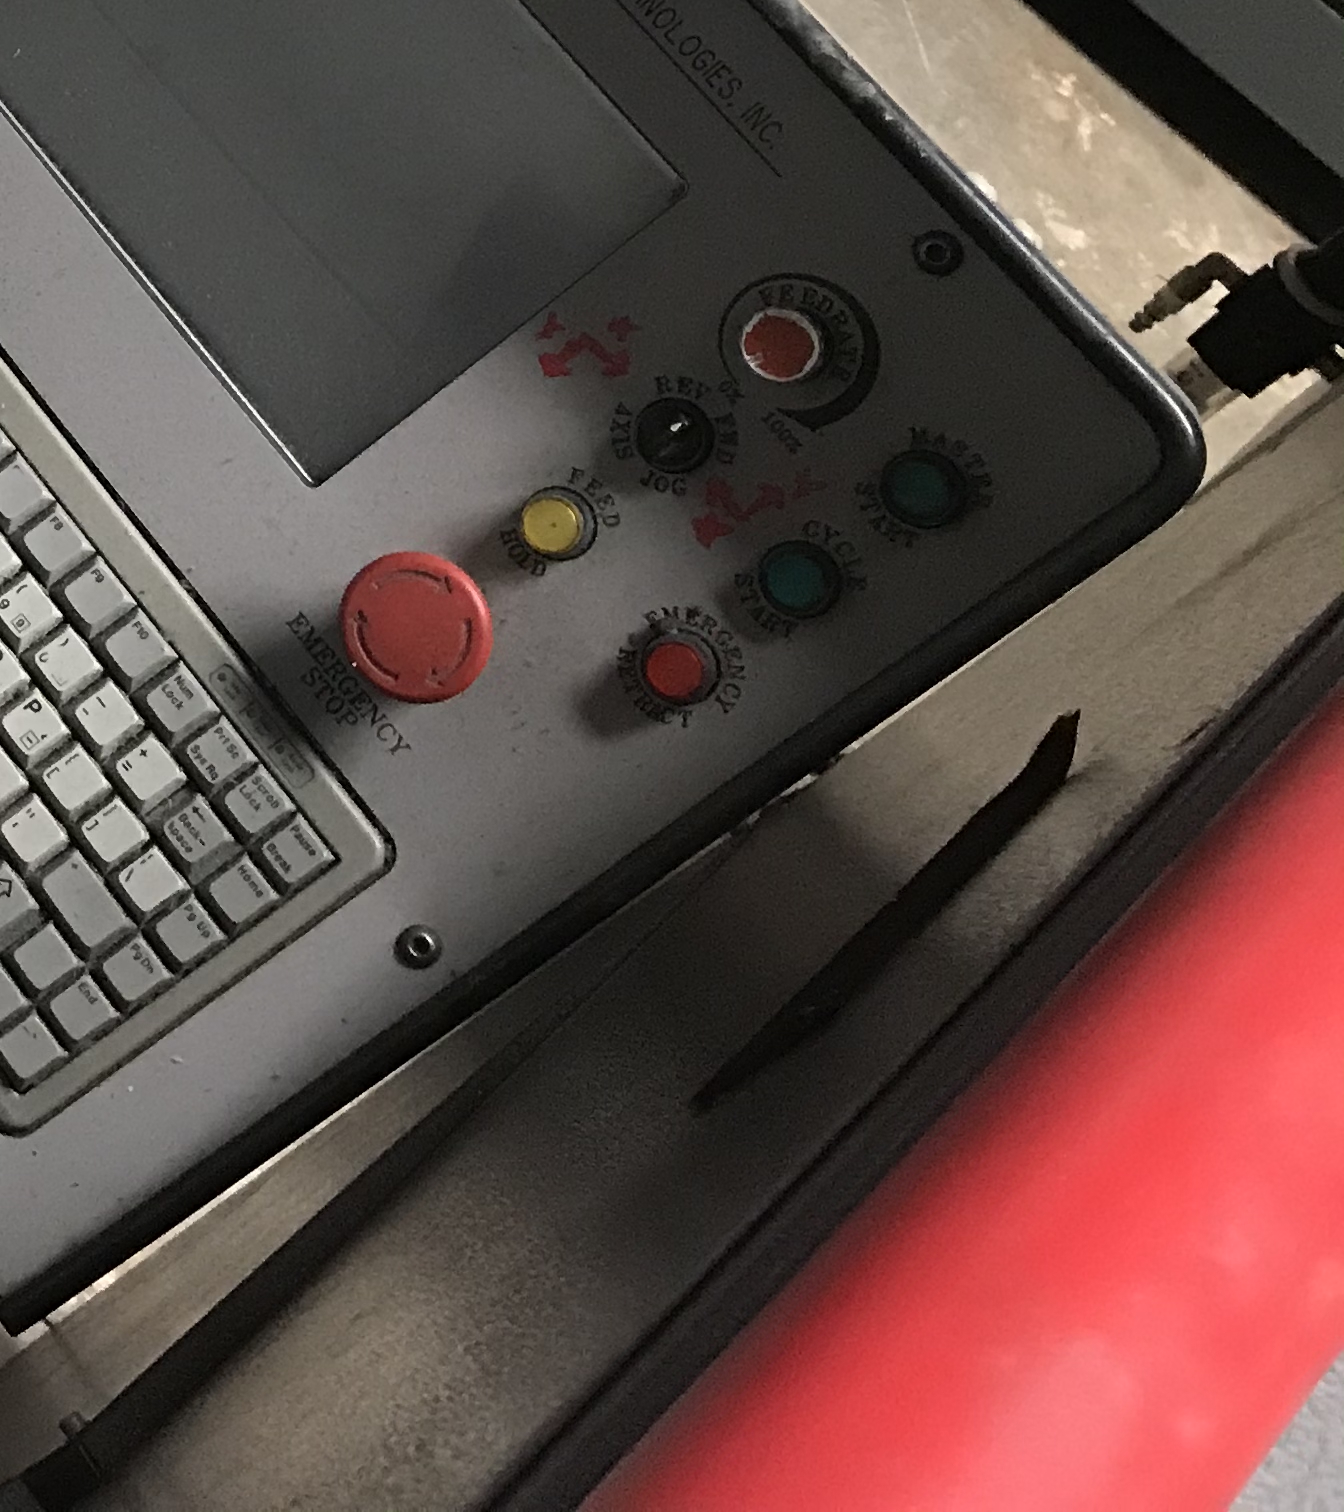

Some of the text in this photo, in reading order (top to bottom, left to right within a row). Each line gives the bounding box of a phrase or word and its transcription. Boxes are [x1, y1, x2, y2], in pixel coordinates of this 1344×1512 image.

[741, 101, 783, 151] INC.
[568, 466, 621, 529] FEED
[640, 470, 687, 497] JOG
[162, 683, 184, 710] Lock
[285, 611, 412, 755] EMERGENCY
[302, 669, 359, 728] STOP
[251, 776, 280, 809] Scroll
